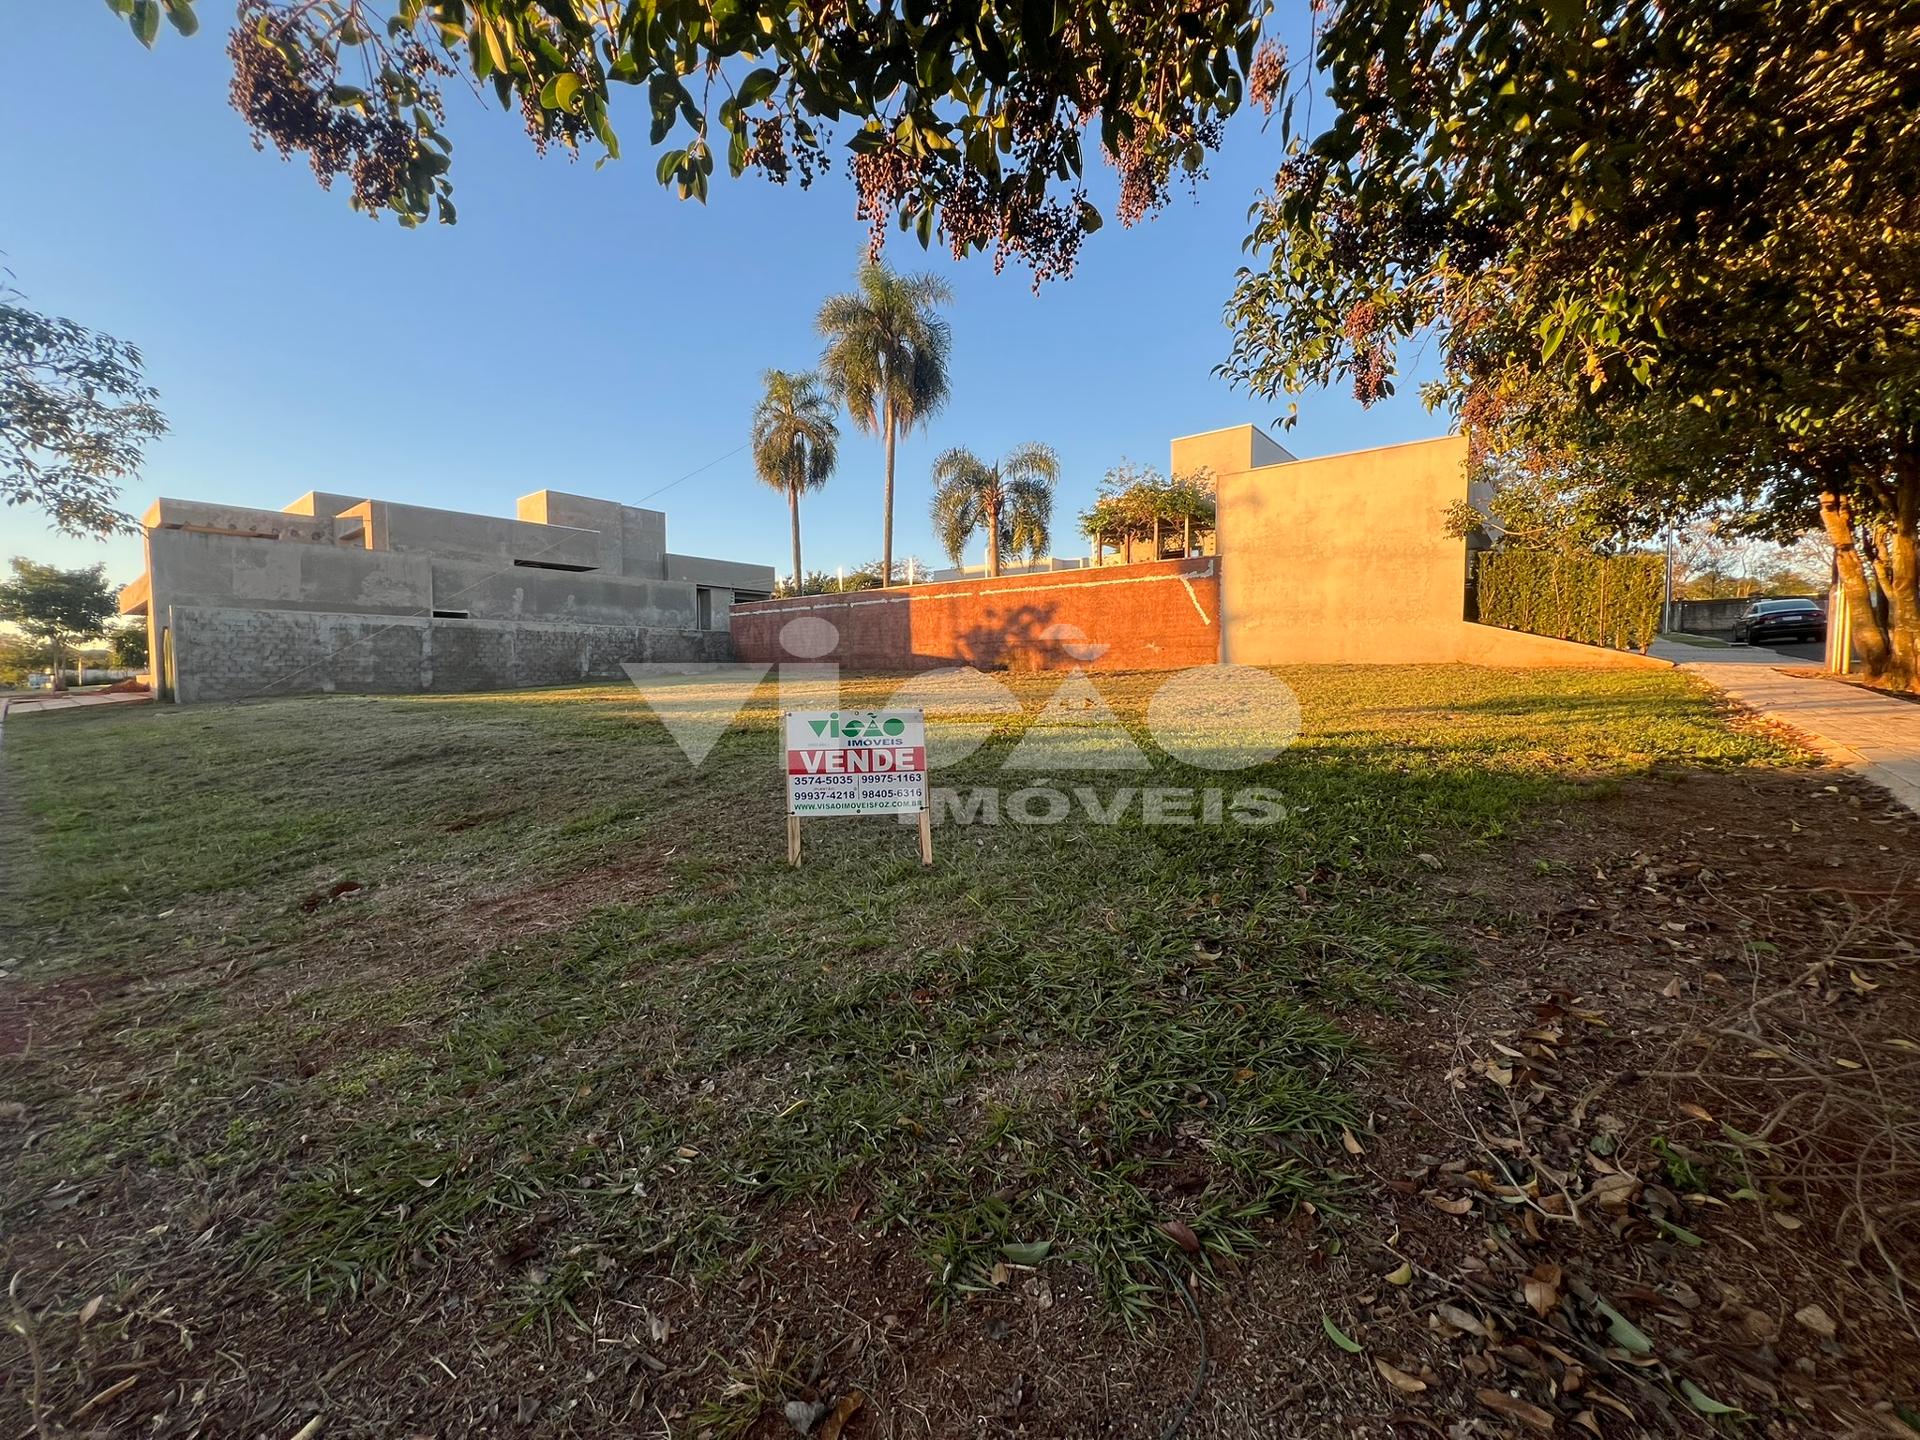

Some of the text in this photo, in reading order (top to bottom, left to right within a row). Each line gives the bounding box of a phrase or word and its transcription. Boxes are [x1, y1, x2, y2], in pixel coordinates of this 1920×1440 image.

[847, 738, 903, 747] IMÓVEIS
[800, 748, 915, 774] VENDE
[794, 773, 922, 786] 3574-5035 99975-1163
[794, 788, 922, 801] 99937-4218 98405-6316
